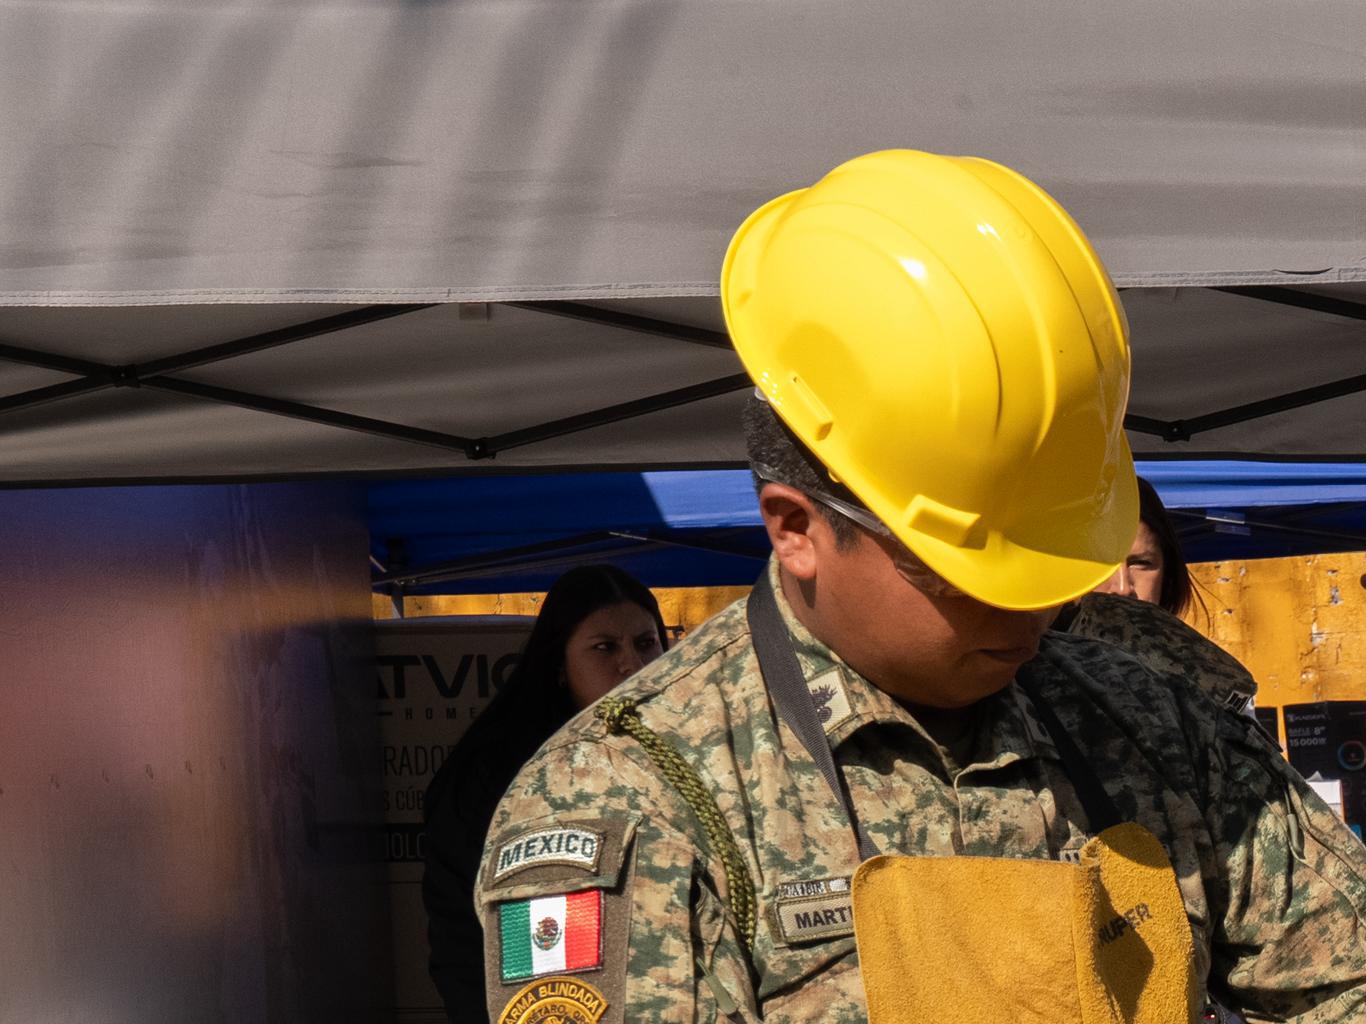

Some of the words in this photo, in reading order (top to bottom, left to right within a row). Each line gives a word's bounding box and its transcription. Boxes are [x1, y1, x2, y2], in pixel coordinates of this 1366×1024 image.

[405, 707, 481, 720] HOME
[499, 833, 595, 870] MEXICO
[538, 982, 600, 1014] BLINDADA
